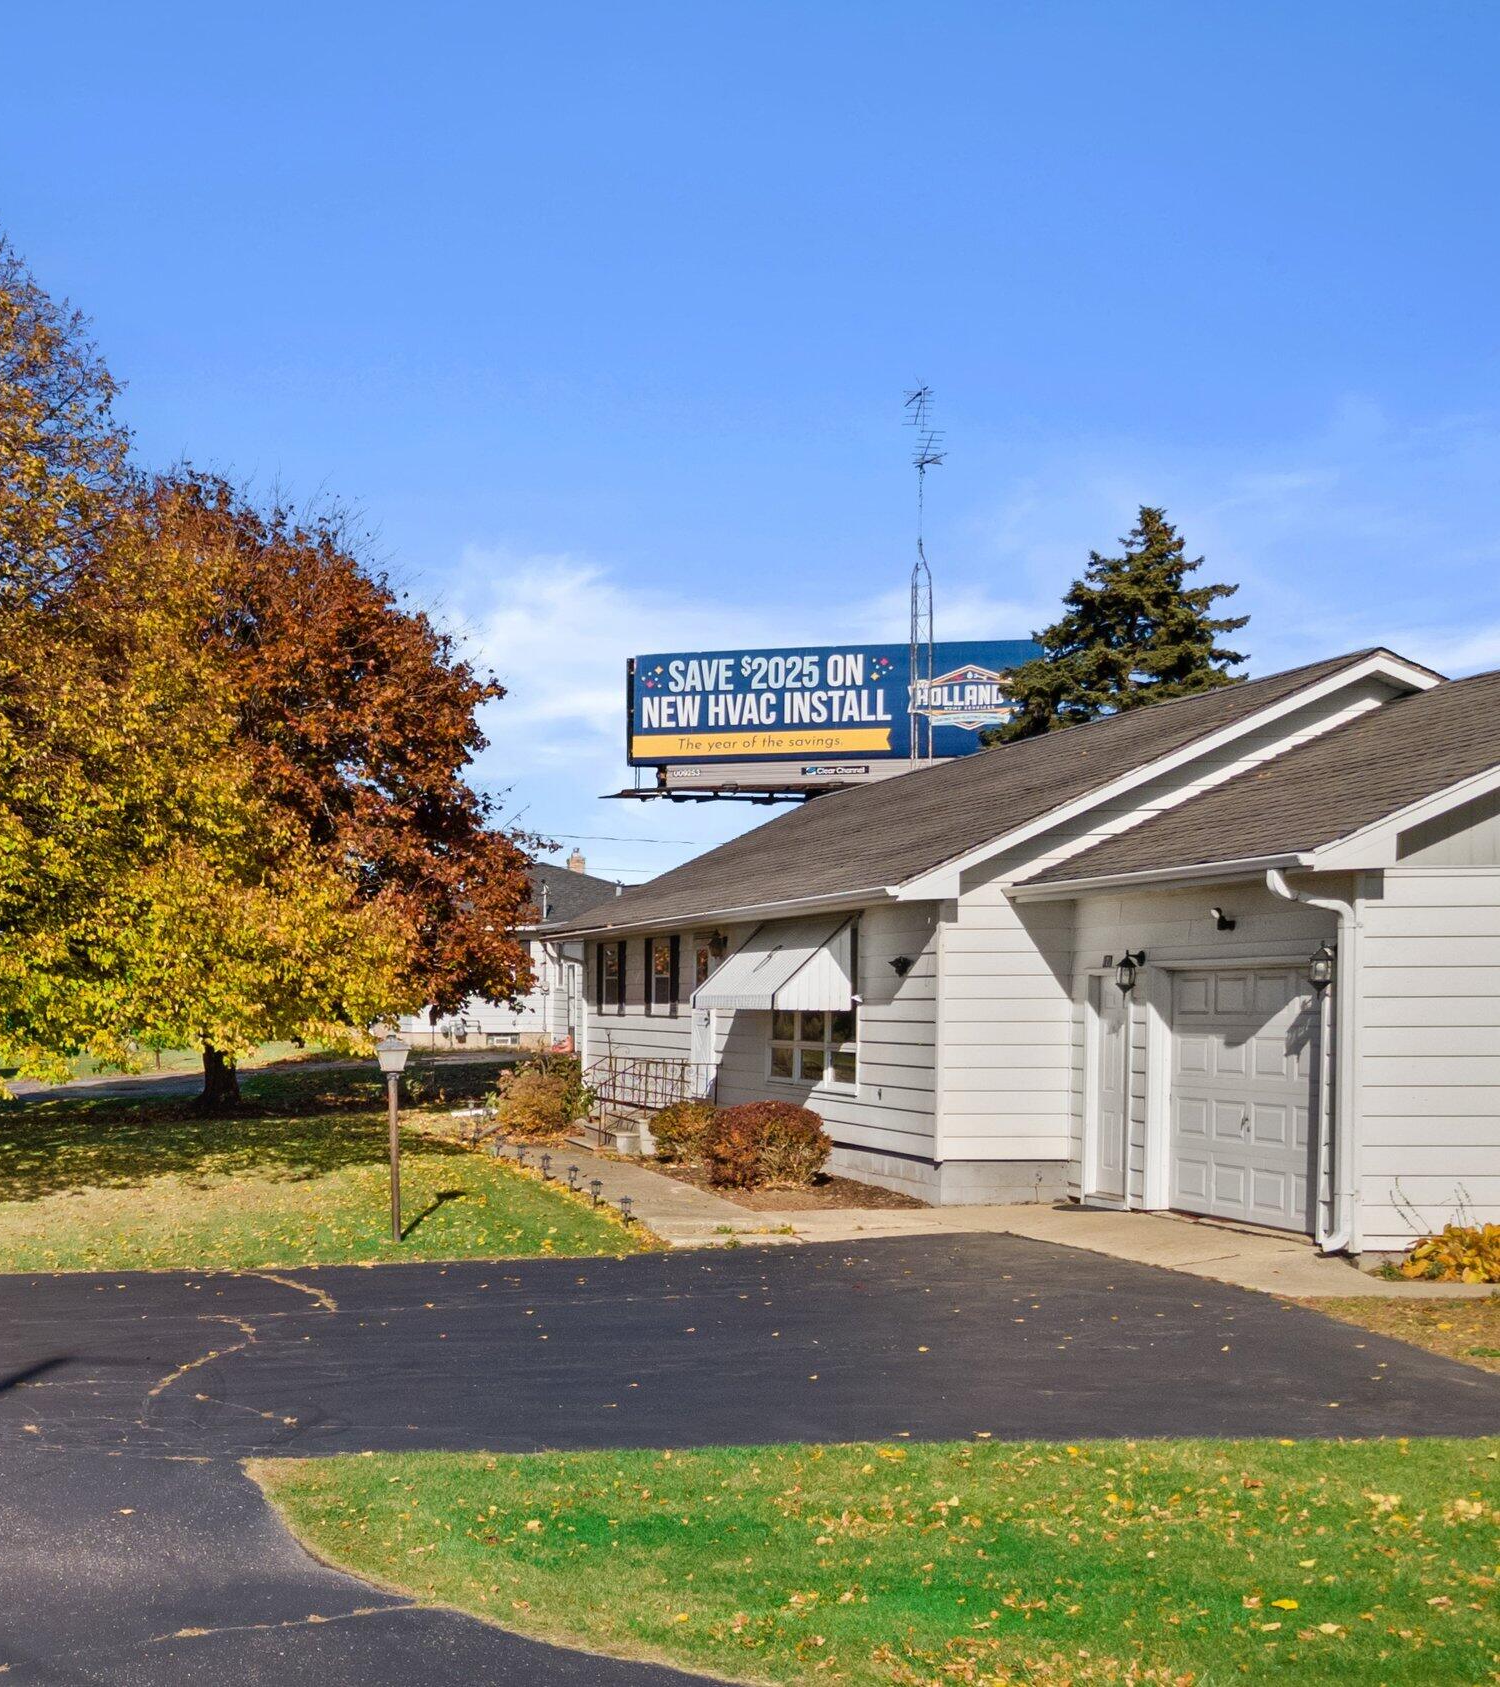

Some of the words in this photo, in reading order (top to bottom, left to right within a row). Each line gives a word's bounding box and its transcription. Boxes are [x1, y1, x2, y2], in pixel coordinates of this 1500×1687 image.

[668, 659, 735, 693] SAVE
[741, 655, 820, 690] $2025
[826, 653, 864, 687] ON
[642, 694, 701, 729] NEW
[708, 692, 777, 727] HVAC
[784, 689, 892, 724] INSTALL
[678, 737, 701, 751] The
[708, 740, 738, 752] year
[742, 735, 757, 749] of
[762, 735, 784, 748] the
[816, 766, 836, 775] Clear
[836, 765, 866, 775] Channel
